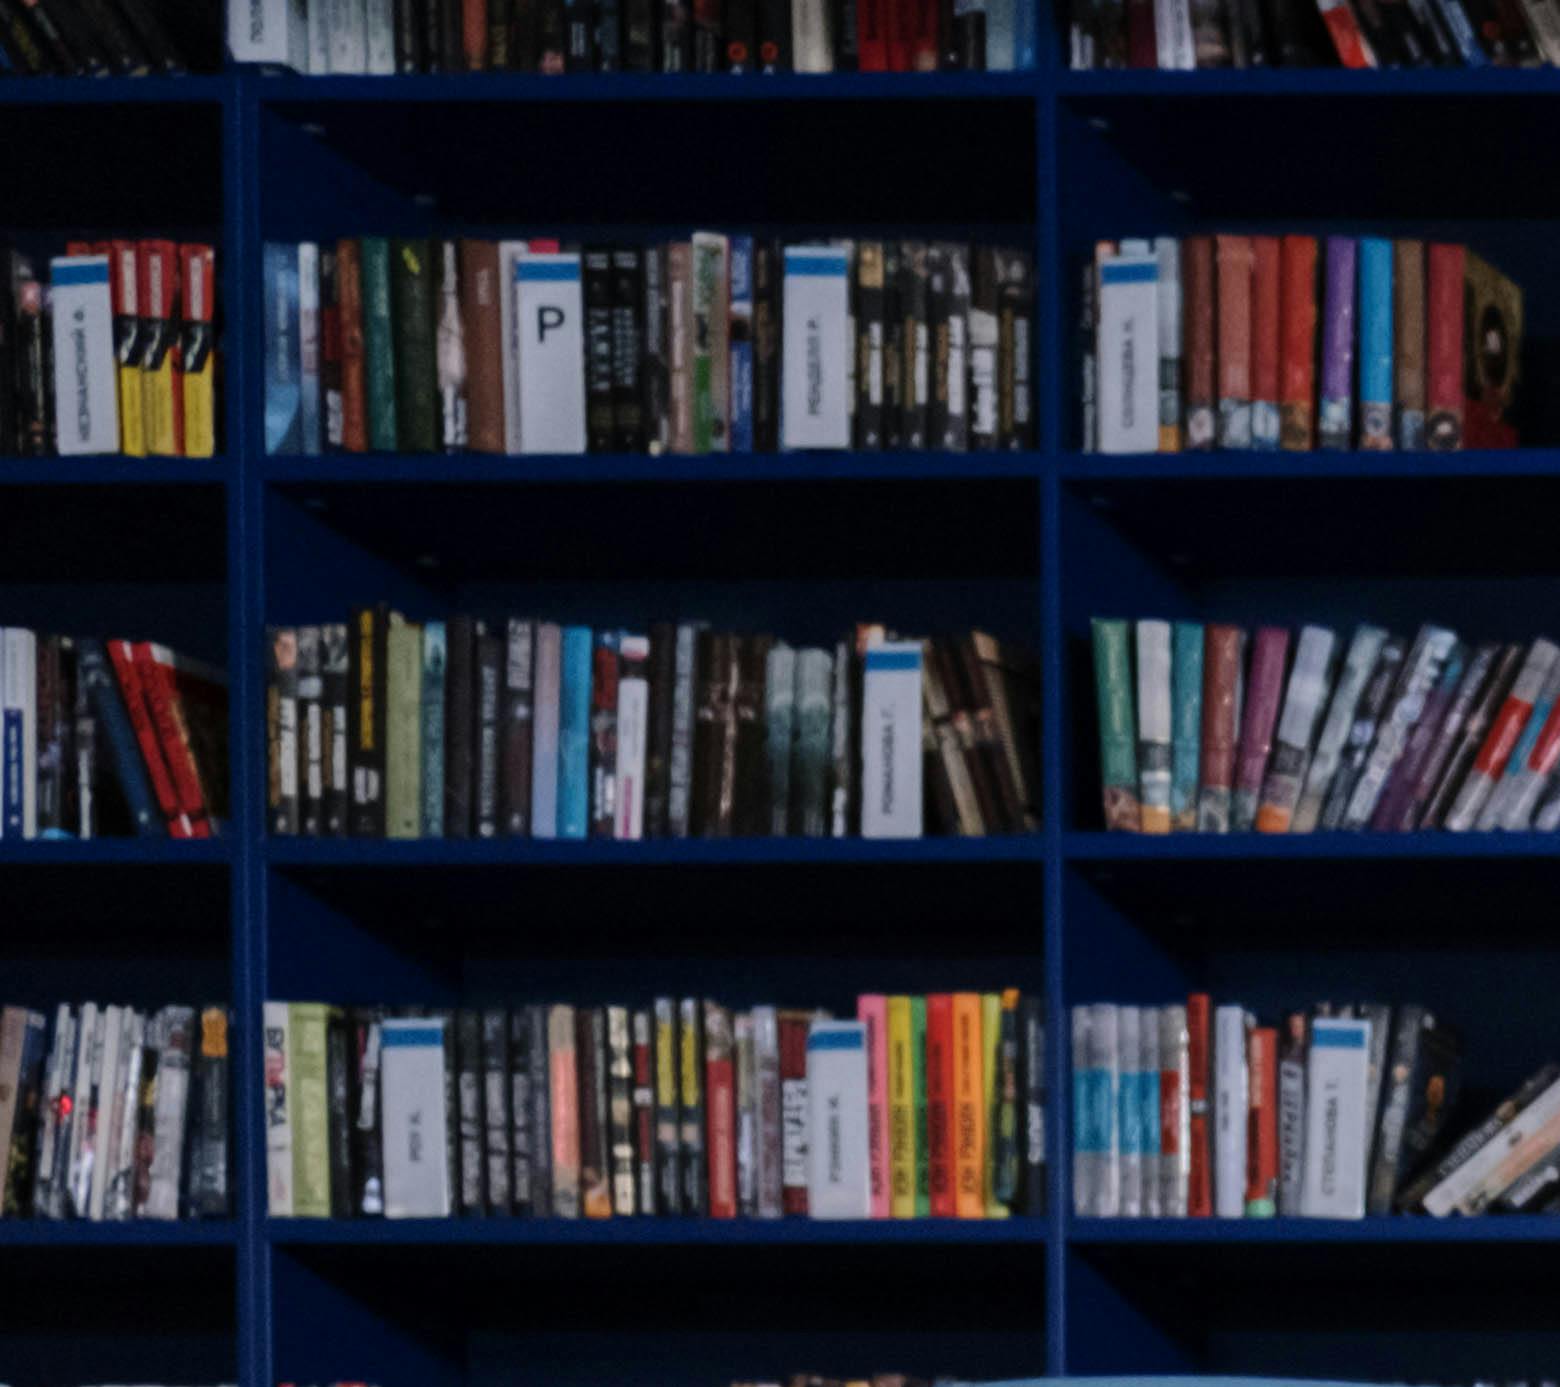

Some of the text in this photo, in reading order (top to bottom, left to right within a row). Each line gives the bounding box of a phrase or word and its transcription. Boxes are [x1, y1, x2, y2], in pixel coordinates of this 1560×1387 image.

[536, 304, 566, 344] Р
[881, 724, 896, 816] РОМАНОВА
[1320, 1096, 1339, 1197] СТЕПАНОВА
